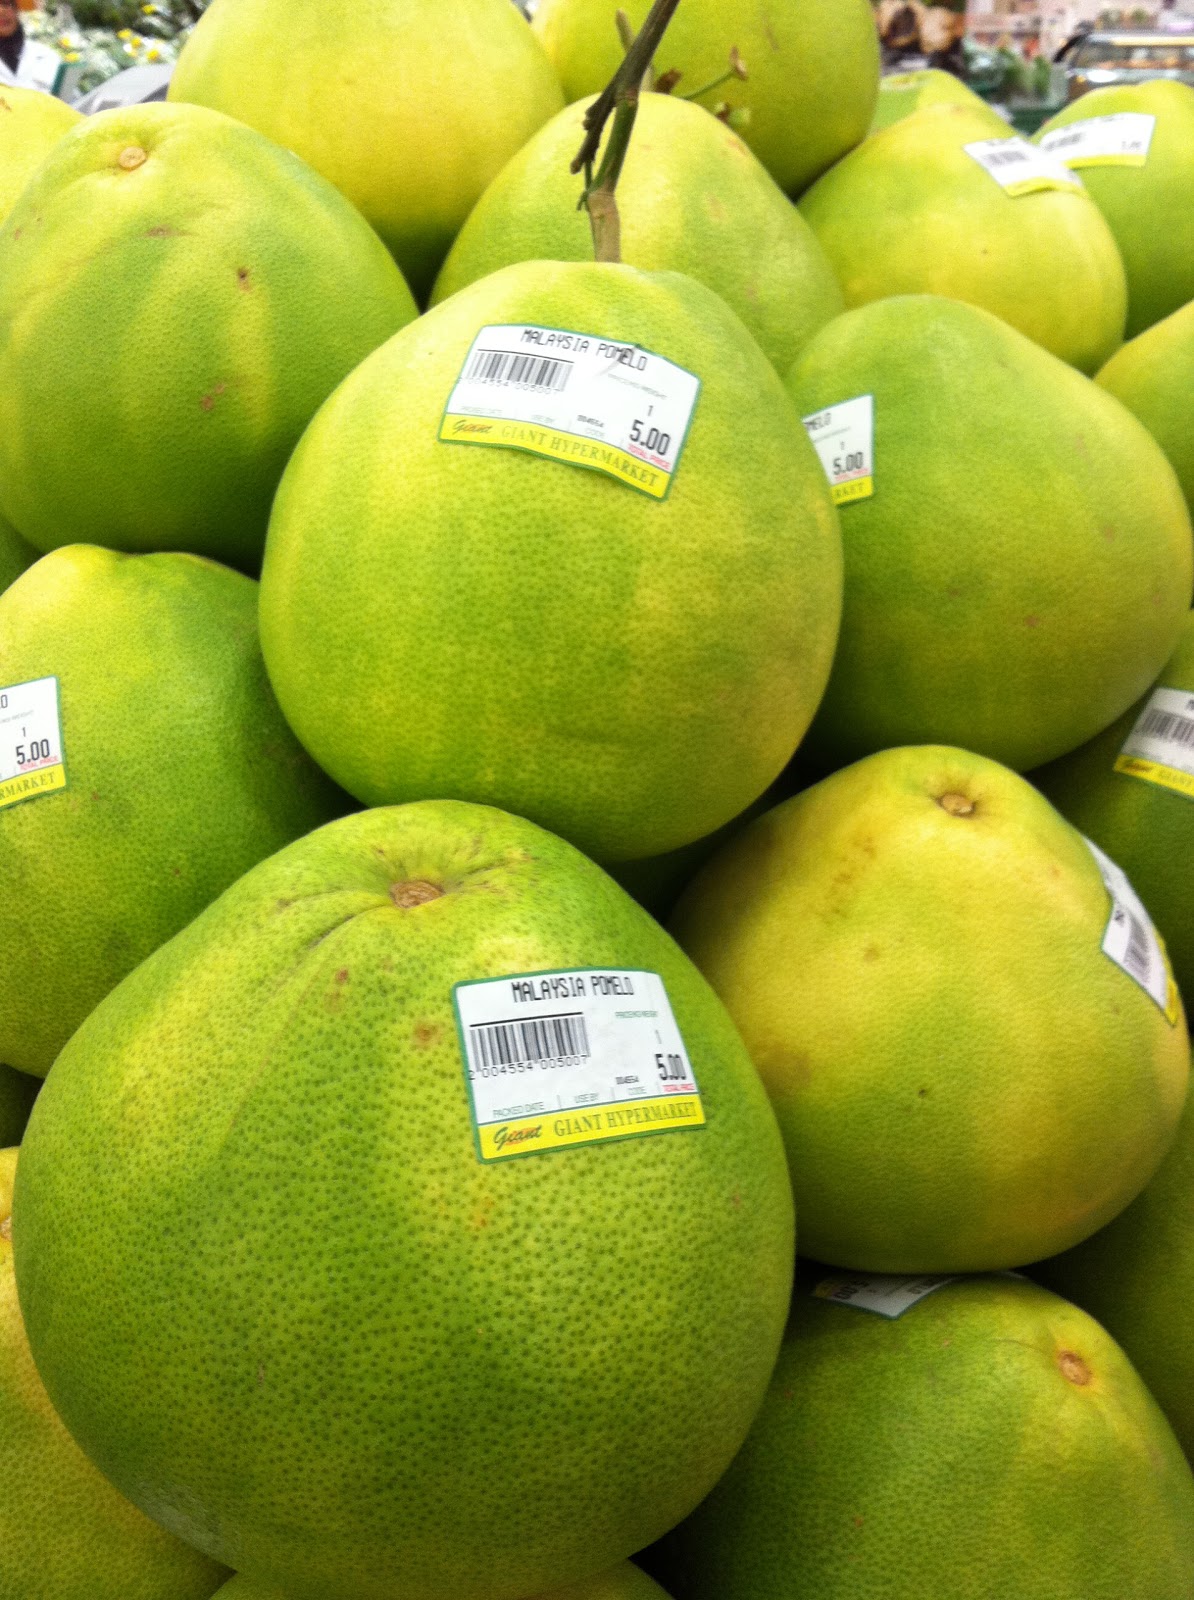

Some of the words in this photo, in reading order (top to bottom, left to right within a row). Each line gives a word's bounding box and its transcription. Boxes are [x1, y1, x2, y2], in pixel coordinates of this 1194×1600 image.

[520, 328, 589, 354] MALAYSIA
[596, 343, 648, 372] POMELO
[629, 419, 671, 456] 5.00
[501, 425, 547, 446] GIANT
[550, 435, 660, 488] HYPERMARKET
[832, 451, 864, 476] 5.00
[16, 738, 50, 765] 5.00
[511, 976, 586, 1003] MALAYSIA
[590, 975, 635, 997] POMELO
[482, 1061, 534, 1079] 004554
[541, 1054, 589, 1071] 005007
[655, 1053, 687, 1081] 5.00
[493, 1124, 542, 1151] Giant
[554, 1114, 602, 1138] GIANT
[607, 1100, 697, 1129] HYPERMARKET
